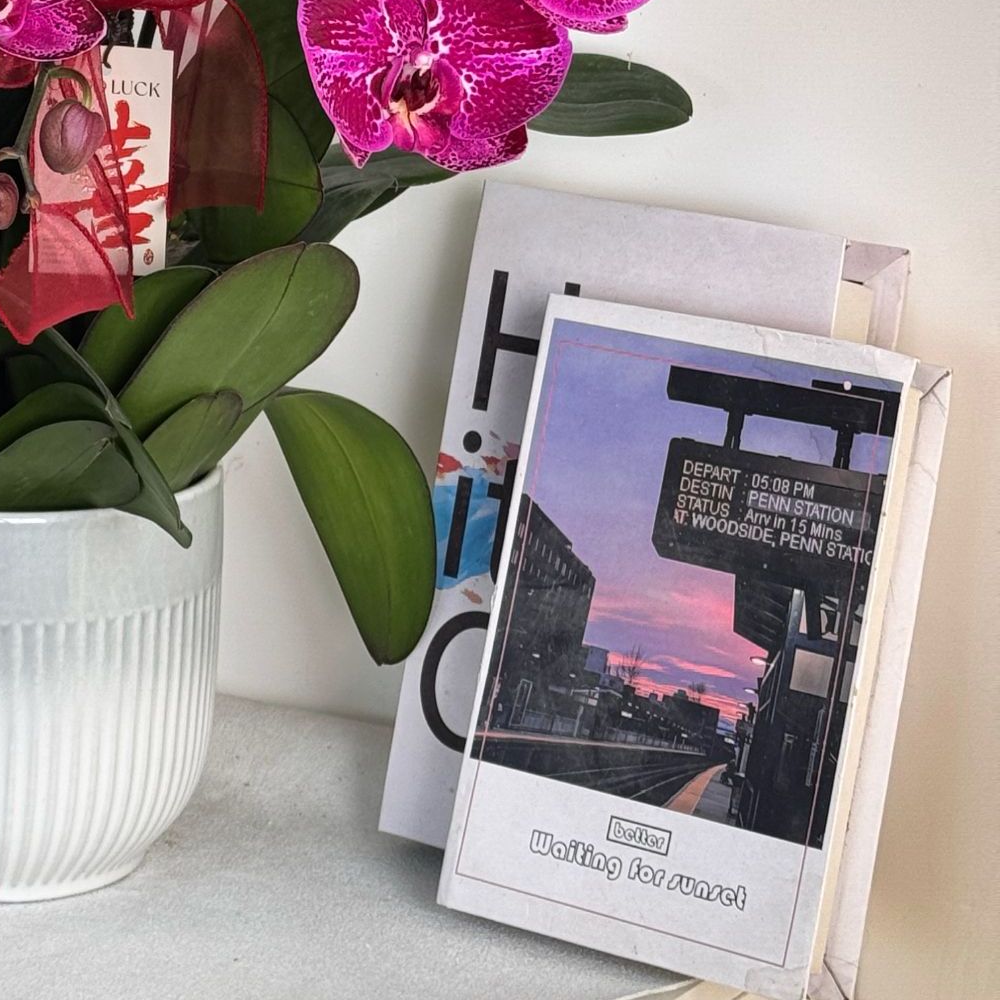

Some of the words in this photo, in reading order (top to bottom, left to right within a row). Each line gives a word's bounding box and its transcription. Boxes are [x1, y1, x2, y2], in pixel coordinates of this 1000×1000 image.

[111, 79, 160, 98] LUCK
[683, 459, 741, 484] DEPART
[751, 473, 790, 494] 05:08
[793, 481, 815, 499] PM
[676, 494, 730, 518] STATUS
[773, 513, 786, 530] in
[790, 517, 808, 534] 15
[810, 521, 843, 542] Mins
[680, 476, 734, 501] DESTIN
[748, 490, 791, 513] PENN
[794, 499, 854, 527] STATION
[692, 512, 775, 548] WOODSIDE,
[779, 531, 823, 555] PENN
[612, 821, 667, 849] better
[529, 828, 623, 881] Waiting
[627, 857, 666, 888] for
[667, 873, 748, 912] sunset
